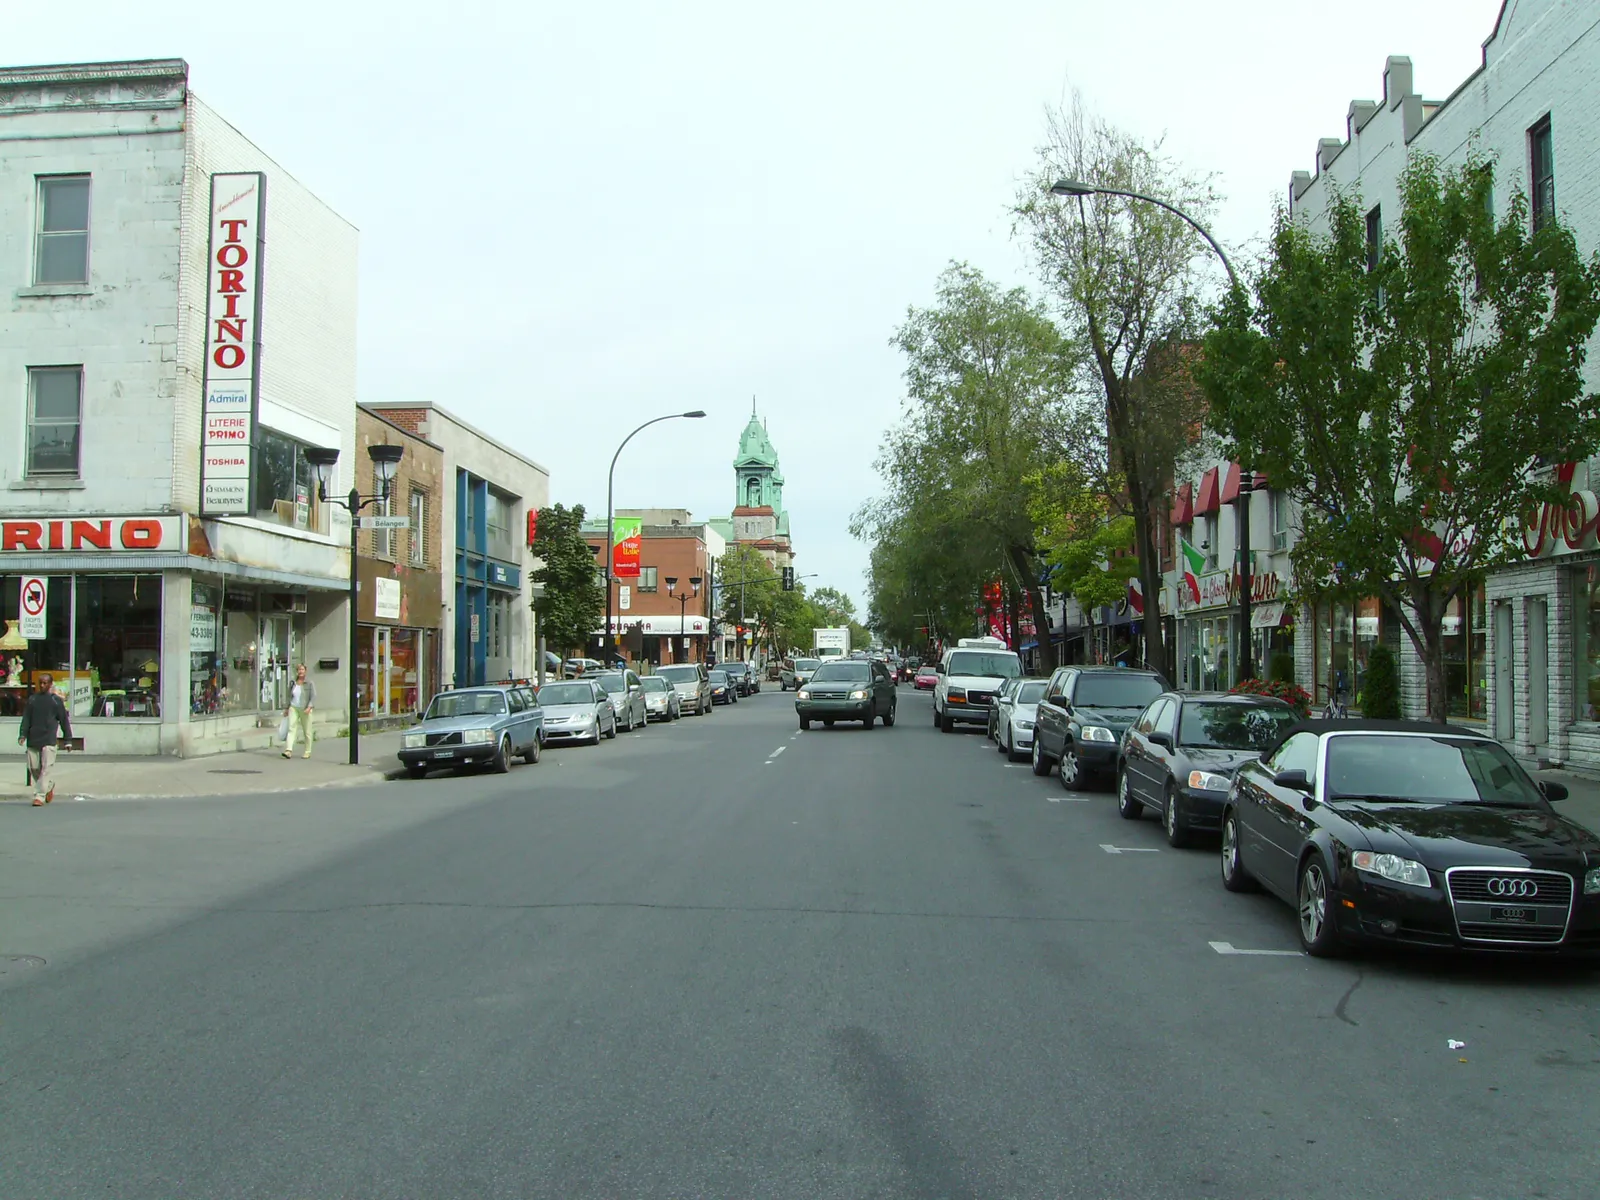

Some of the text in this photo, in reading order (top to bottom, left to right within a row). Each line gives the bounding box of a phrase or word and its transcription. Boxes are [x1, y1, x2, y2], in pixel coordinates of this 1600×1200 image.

[213, 219, 248, 369] TORINO
[209, 394, 247, 403] Admiral
[209, 418, 246, 427] LITERIE
[208, 430, 246, 440] PRIMO
[207, 458, 246, 466] TOSHIBA
[206, 496, 243, 506] Beautyrest
